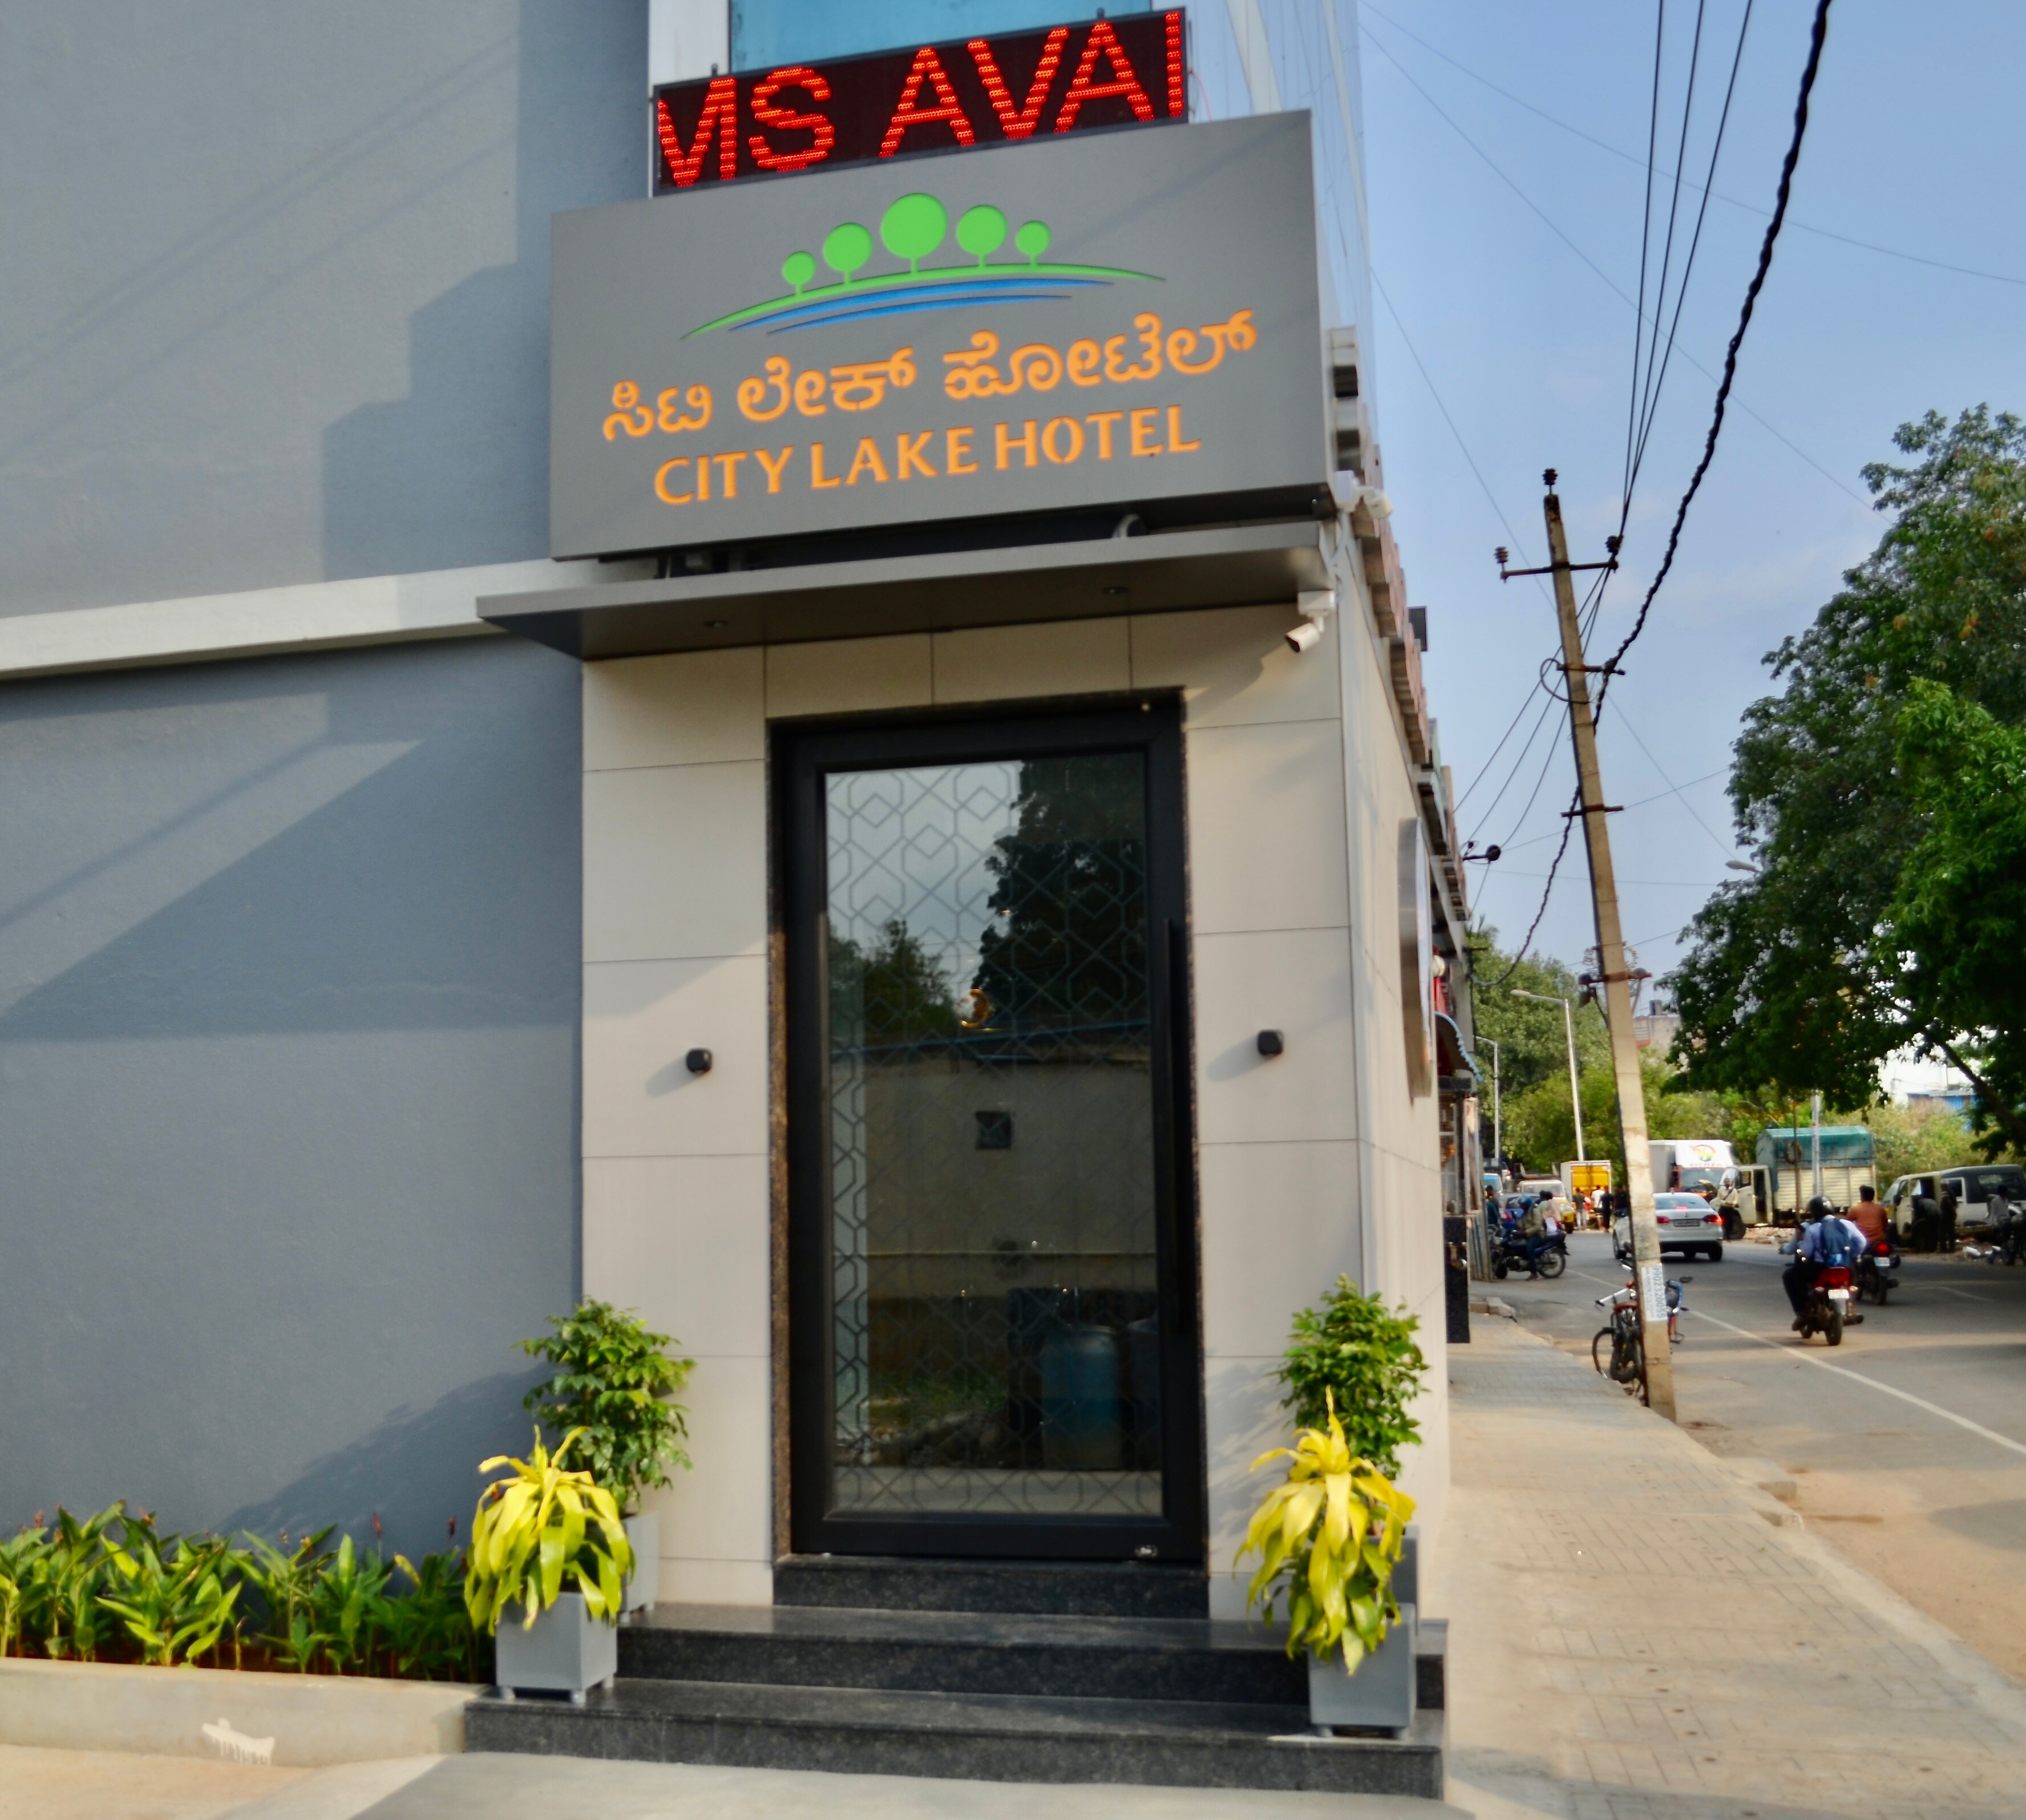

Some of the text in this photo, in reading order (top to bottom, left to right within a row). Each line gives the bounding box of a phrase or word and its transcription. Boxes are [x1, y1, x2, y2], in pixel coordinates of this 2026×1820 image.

[879, 11, 1184, 158] AVAI
[602, 308, 1258, 442] ಸಿಟಿ ಲೇಕ್ ಹೋಟೆಲ್
[654, 405, 1202, 505] CITY LAKE HOTEL
